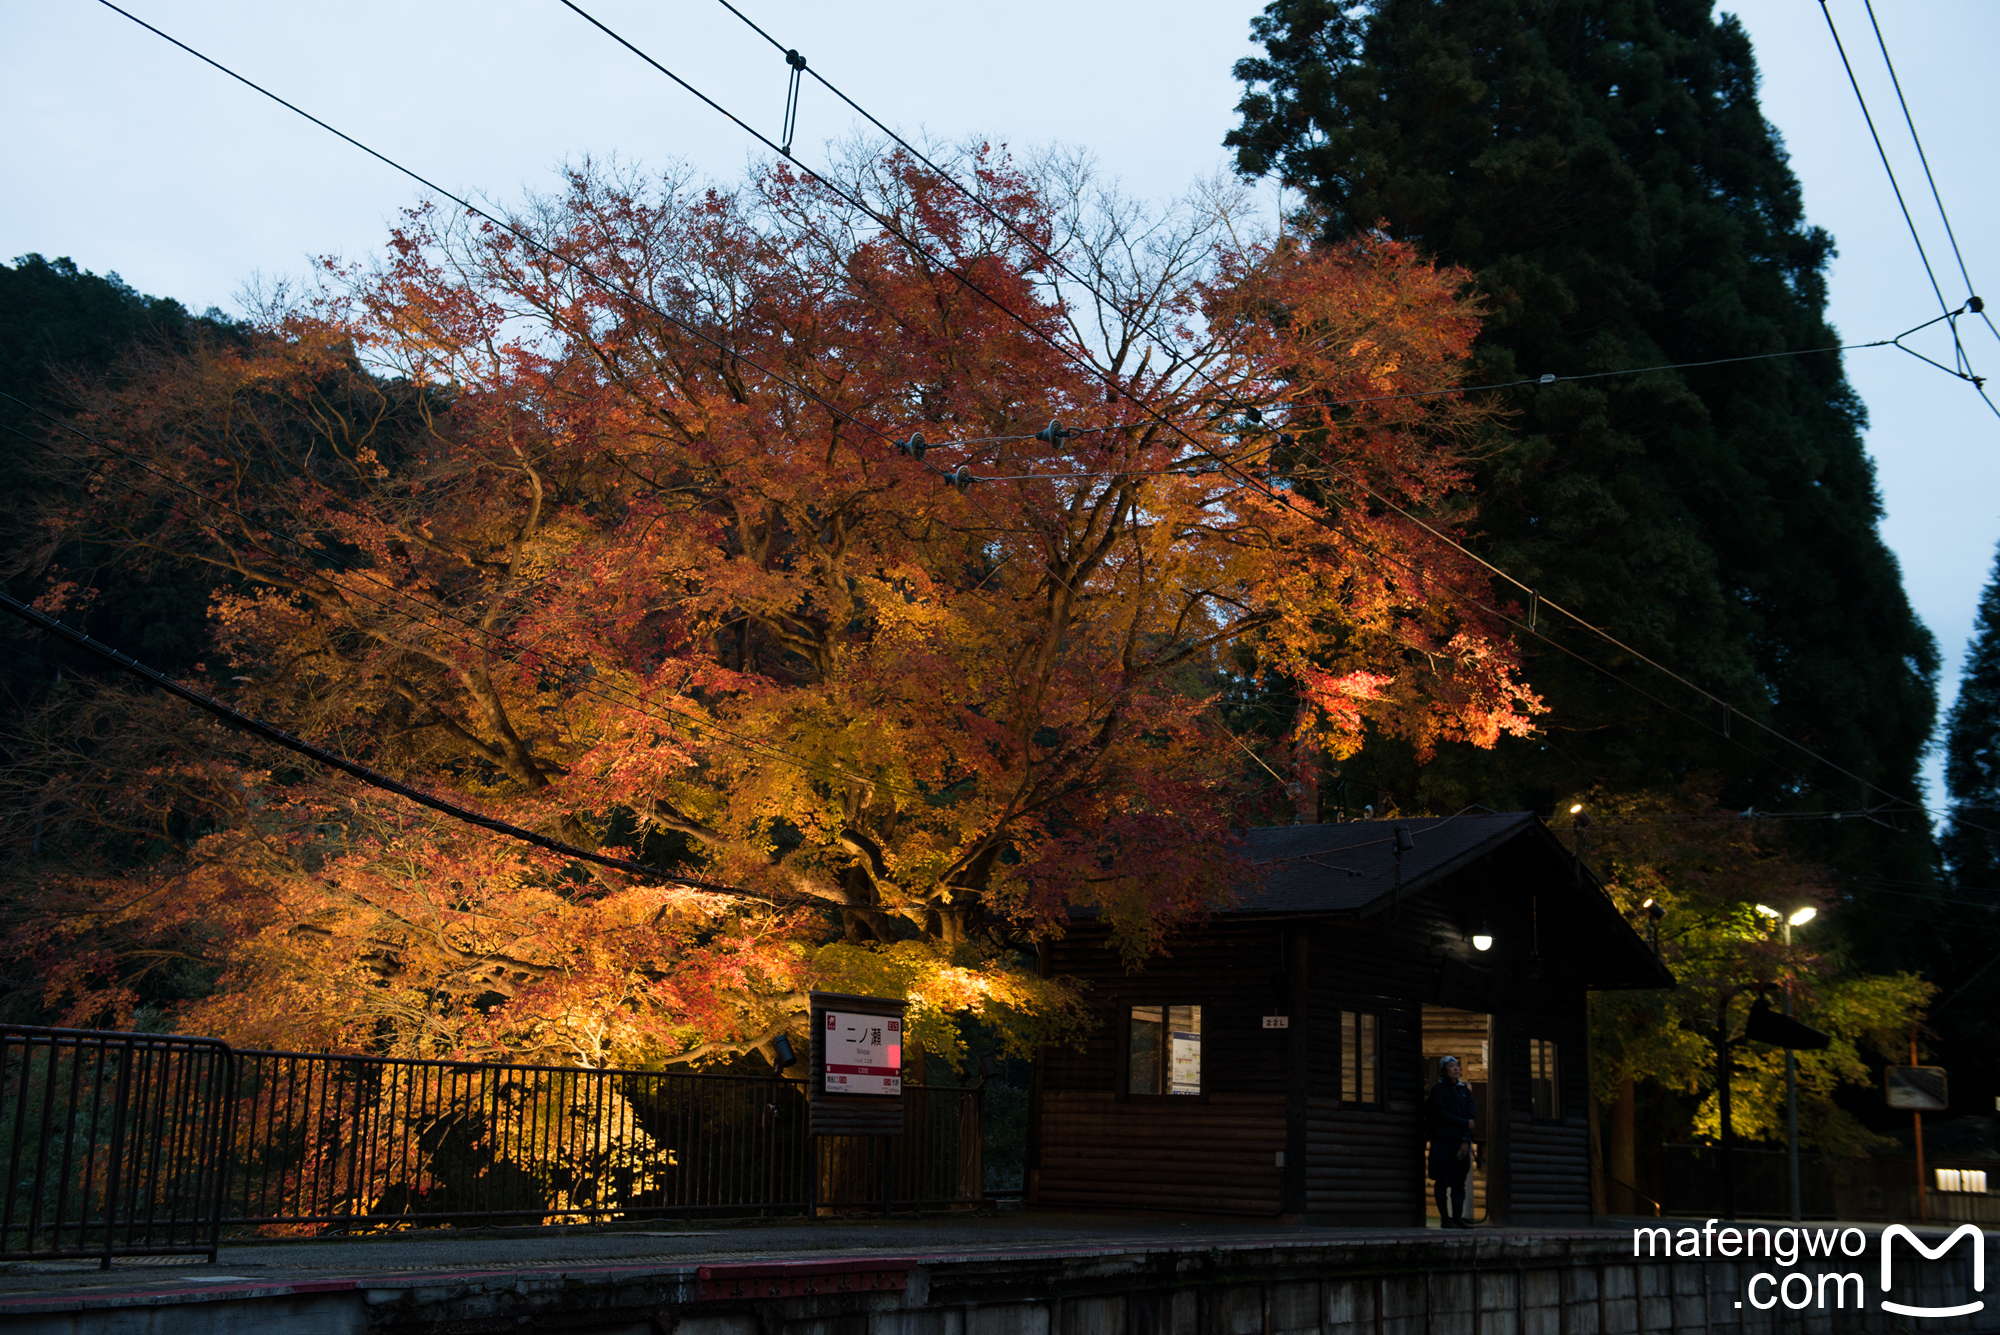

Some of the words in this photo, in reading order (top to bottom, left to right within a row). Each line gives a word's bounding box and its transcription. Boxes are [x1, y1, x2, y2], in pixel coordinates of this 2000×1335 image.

[889, 1022, 899, 1031] E15
[1266, 1019, 1285, 1027] 22L
[846, 1027, 882, 1046] 二ノ瀬
